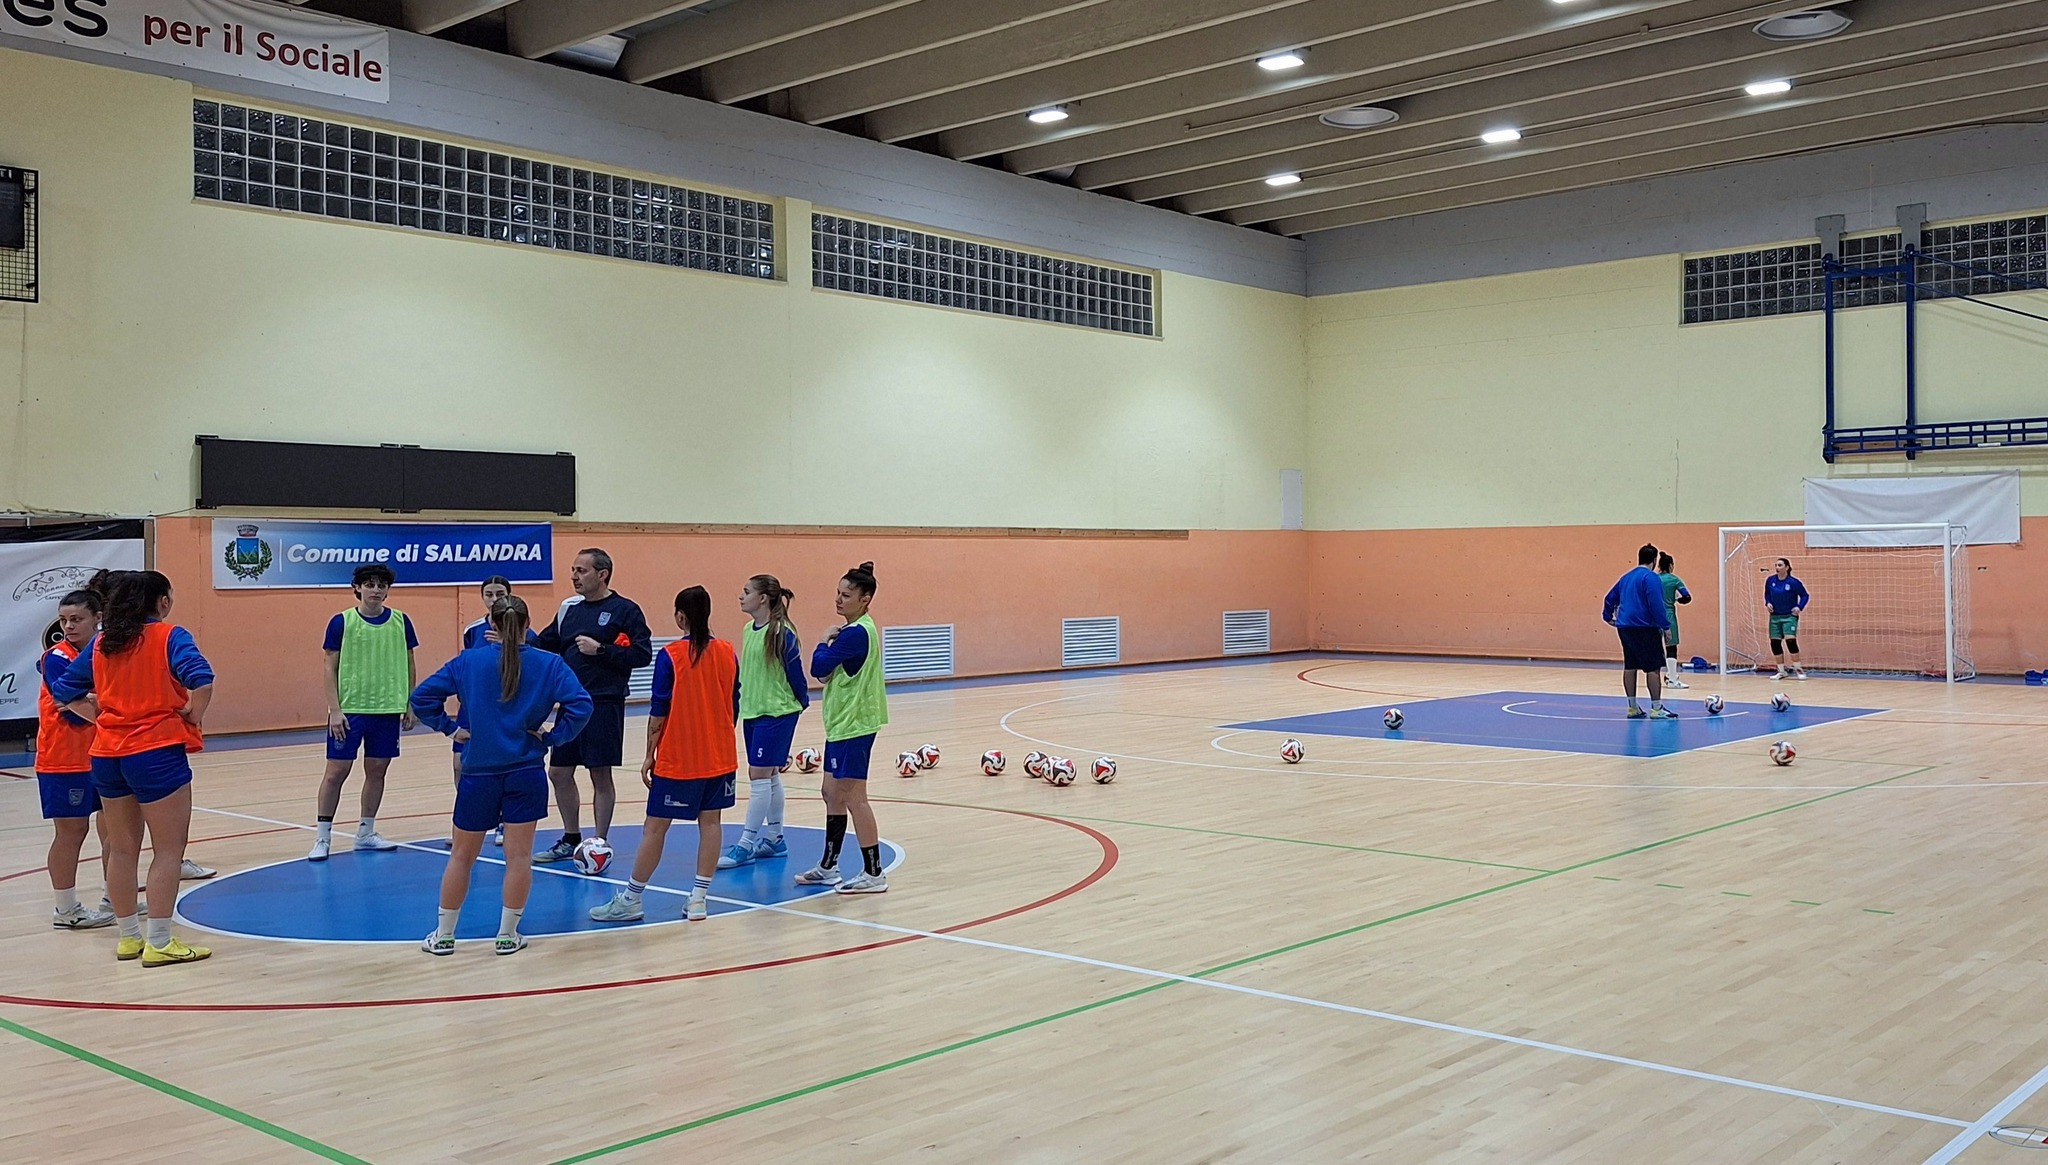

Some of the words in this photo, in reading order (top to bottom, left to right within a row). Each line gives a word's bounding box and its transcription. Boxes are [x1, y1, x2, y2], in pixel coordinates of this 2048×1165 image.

[143, 14, 211, 46] per
[223, 22, 244, 55] il
[256, 31, 383, 83] Sociale
[286, 543, 390, 564] Comune
[395, 543, 419, 562] di
[424, 543, 543, 562] SALANDRA
[757, 747, 764, 758] 5
